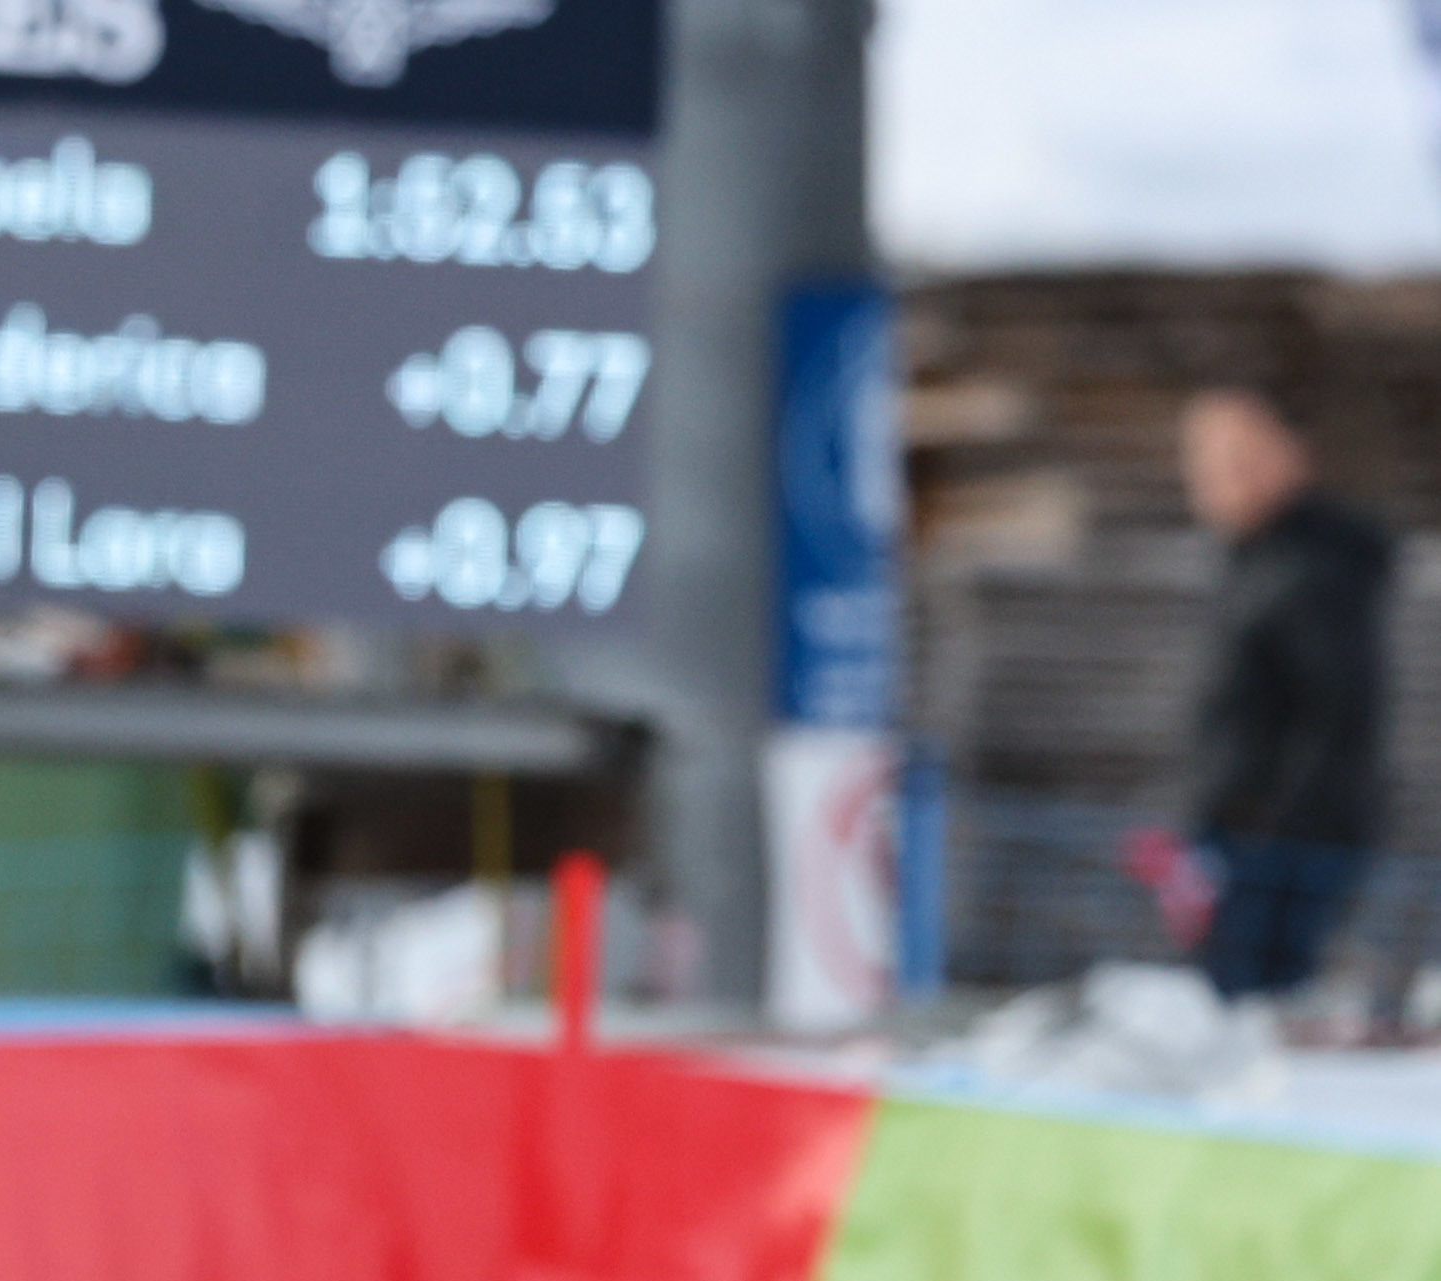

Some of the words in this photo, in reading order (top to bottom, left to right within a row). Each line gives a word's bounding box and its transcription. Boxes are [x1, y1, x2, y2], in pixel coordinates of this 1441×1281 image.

[386, 325, 652, 444] +0.77
[31, 475, 244, 597] Lara
[379, 497, 646, 617] +0.97
